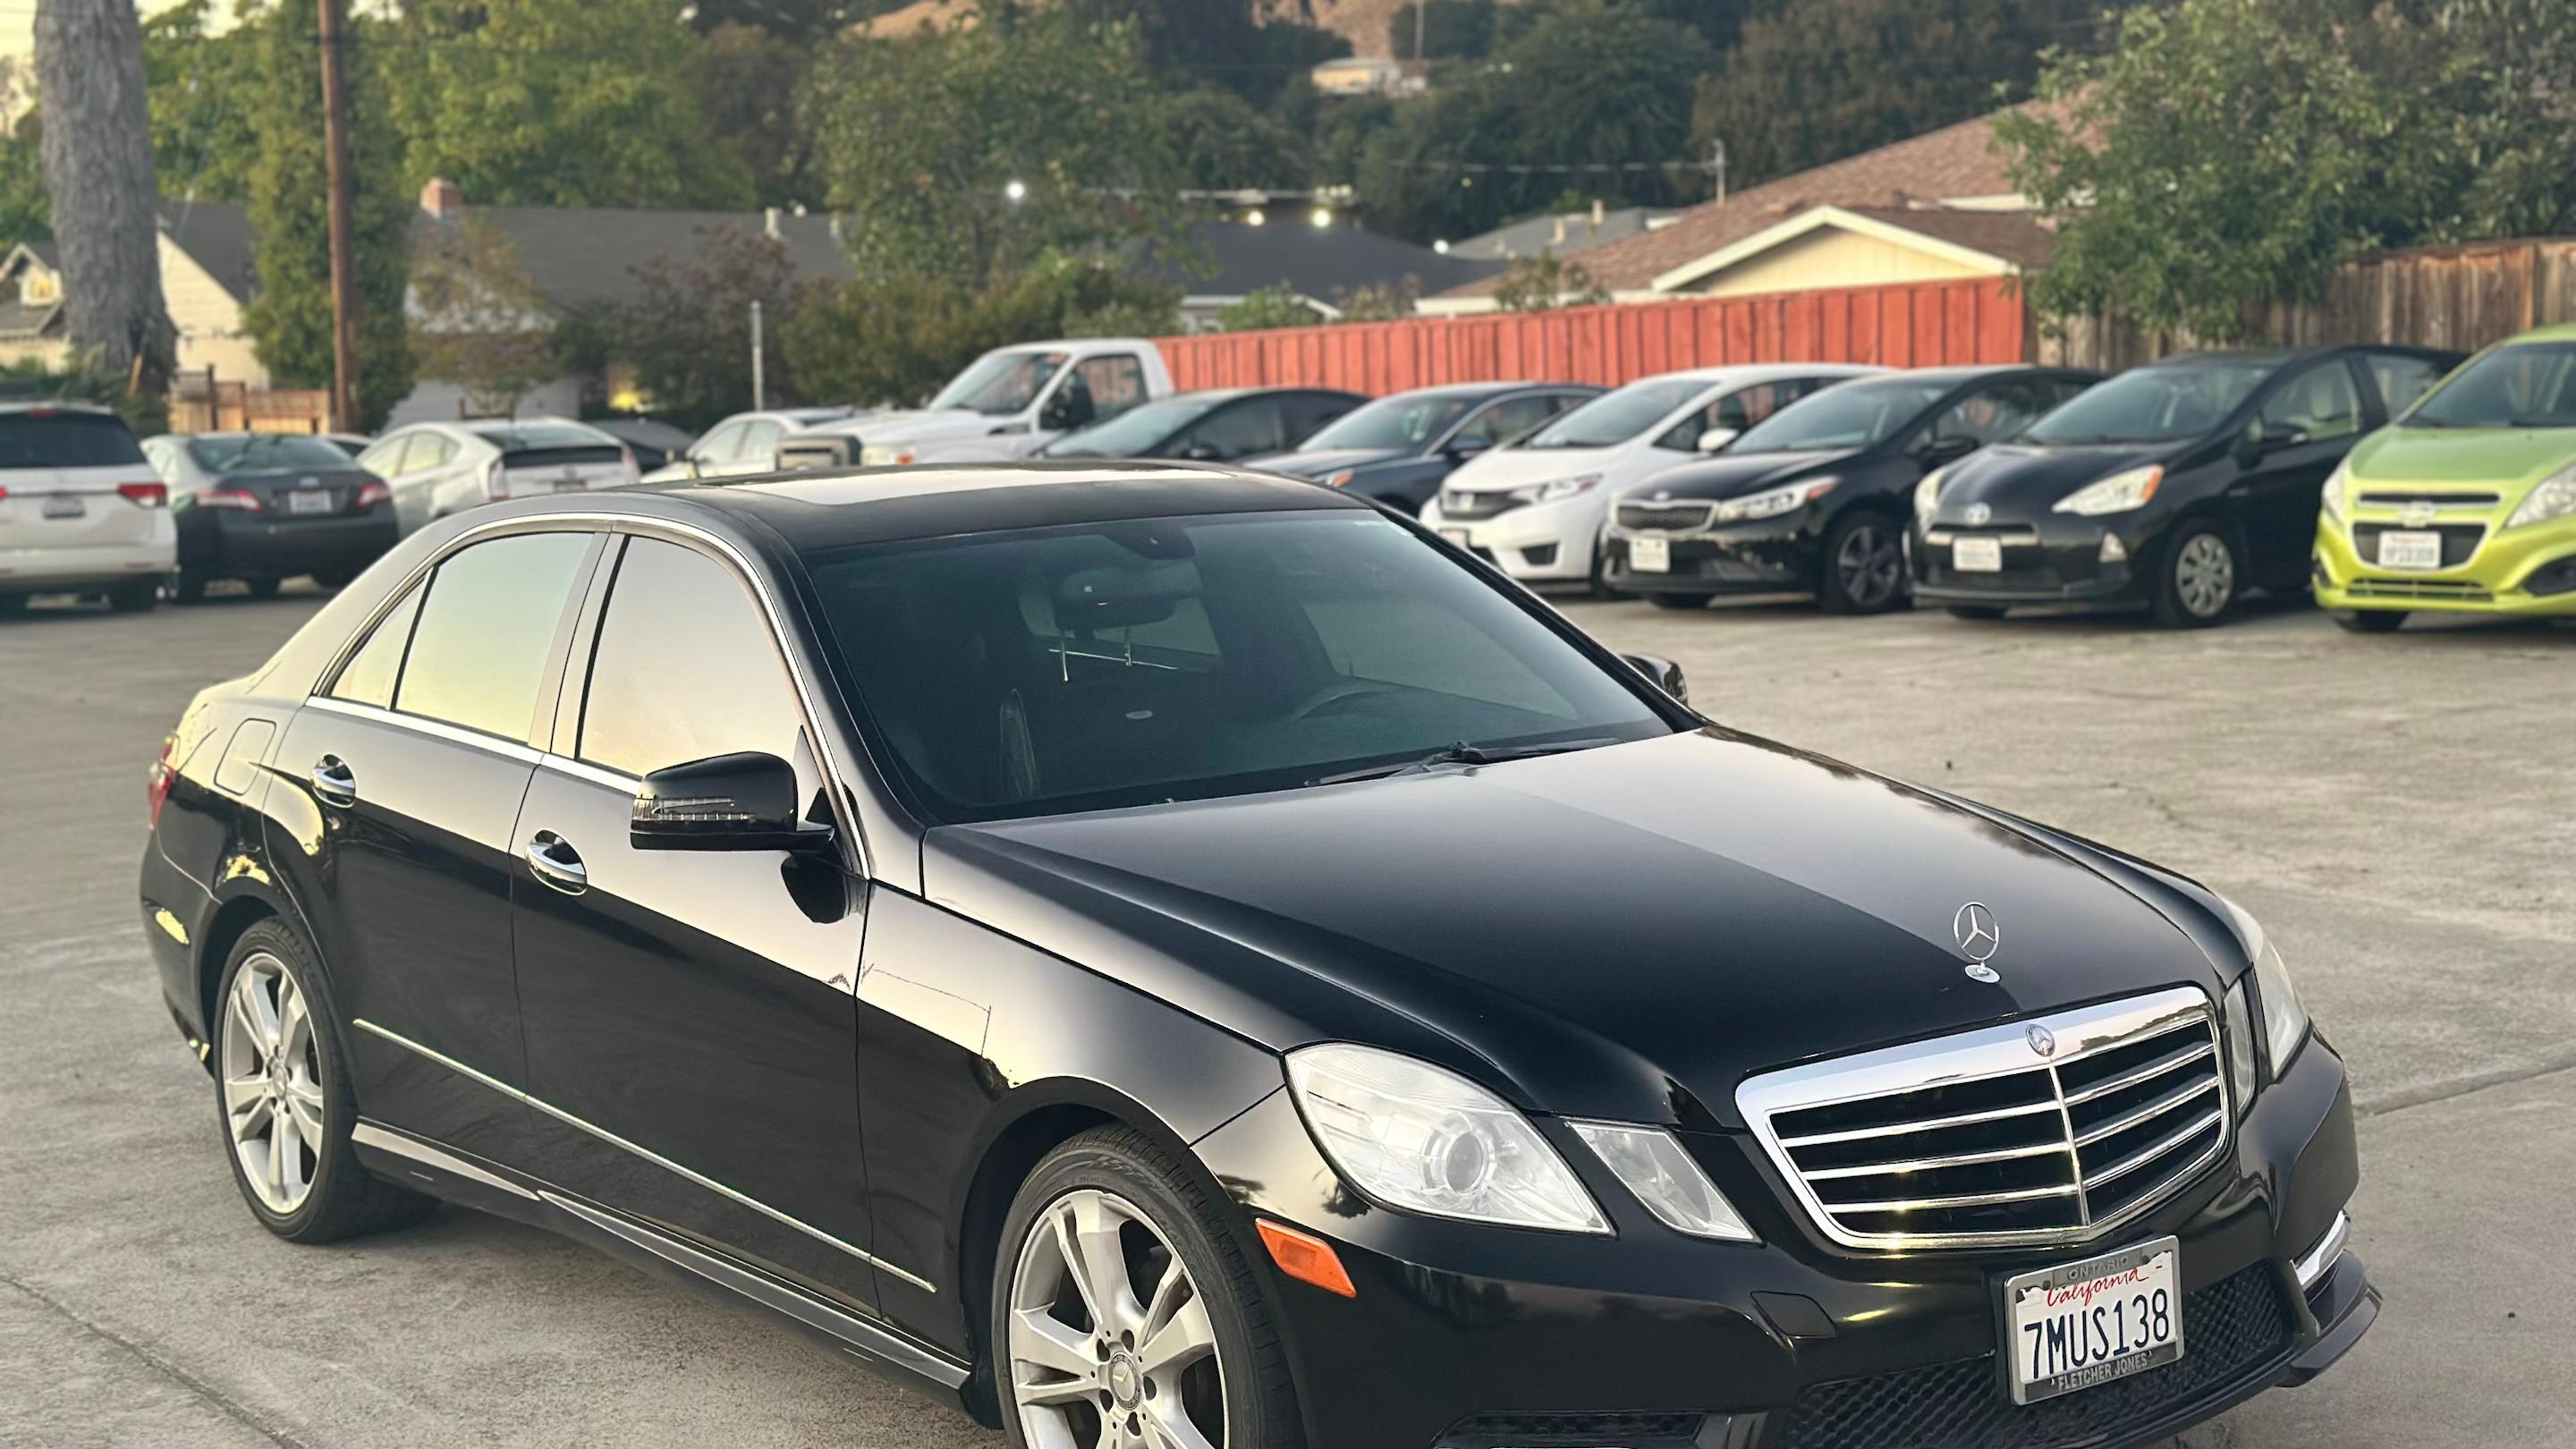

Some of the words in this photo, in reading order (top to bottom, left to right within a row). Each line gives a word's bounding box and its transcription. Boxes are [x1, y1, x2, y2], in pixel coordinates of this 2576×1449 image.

[2046, 1267, 2149, 1307] California
[2068, 1256, 2129, 1280] ONTARIO
[2024, 1288, 2170, 1380] 7MUS138
[2057, 1362, 2112, 1391] FLETCHER
[2114, 1352, 2148, 1376] JONES
